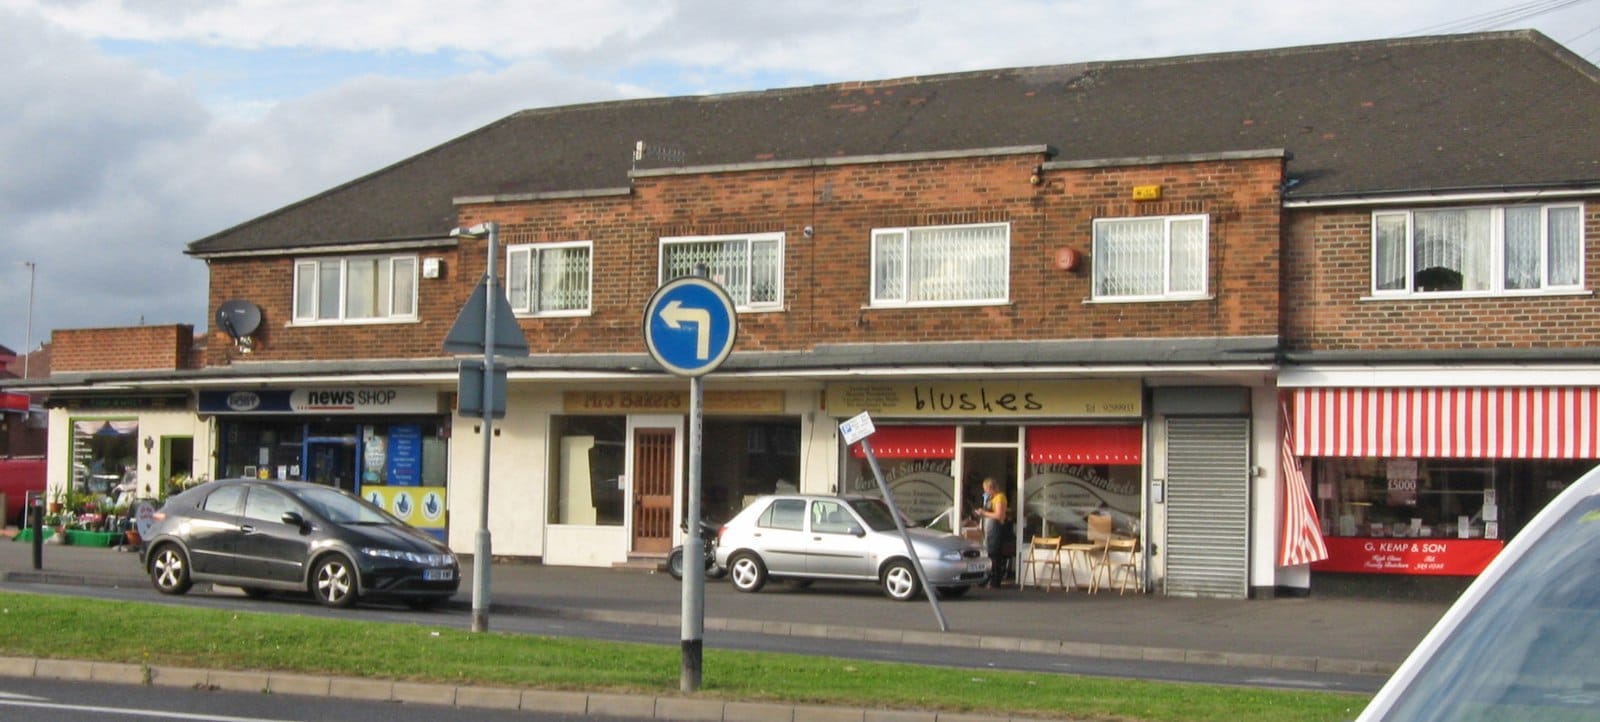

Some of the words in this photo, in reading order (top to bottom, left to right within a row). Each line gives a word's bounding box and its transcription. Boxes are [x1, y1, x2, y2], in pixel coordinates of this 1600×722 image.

[308, 391, 355, 404] news
[358, 391, 396, 404] SHOP
[583, 391, 614, 408] Mrs
[619, 391, 681, 408] Bakers
[914, 386, 1043, 412] blushes
[855, 467, 897, 490] Vertal
[1379, 543, 1408, 552] KEMP
[1411, 544, 1419, 553] &
[1422, 544, 1447, 553] SON
